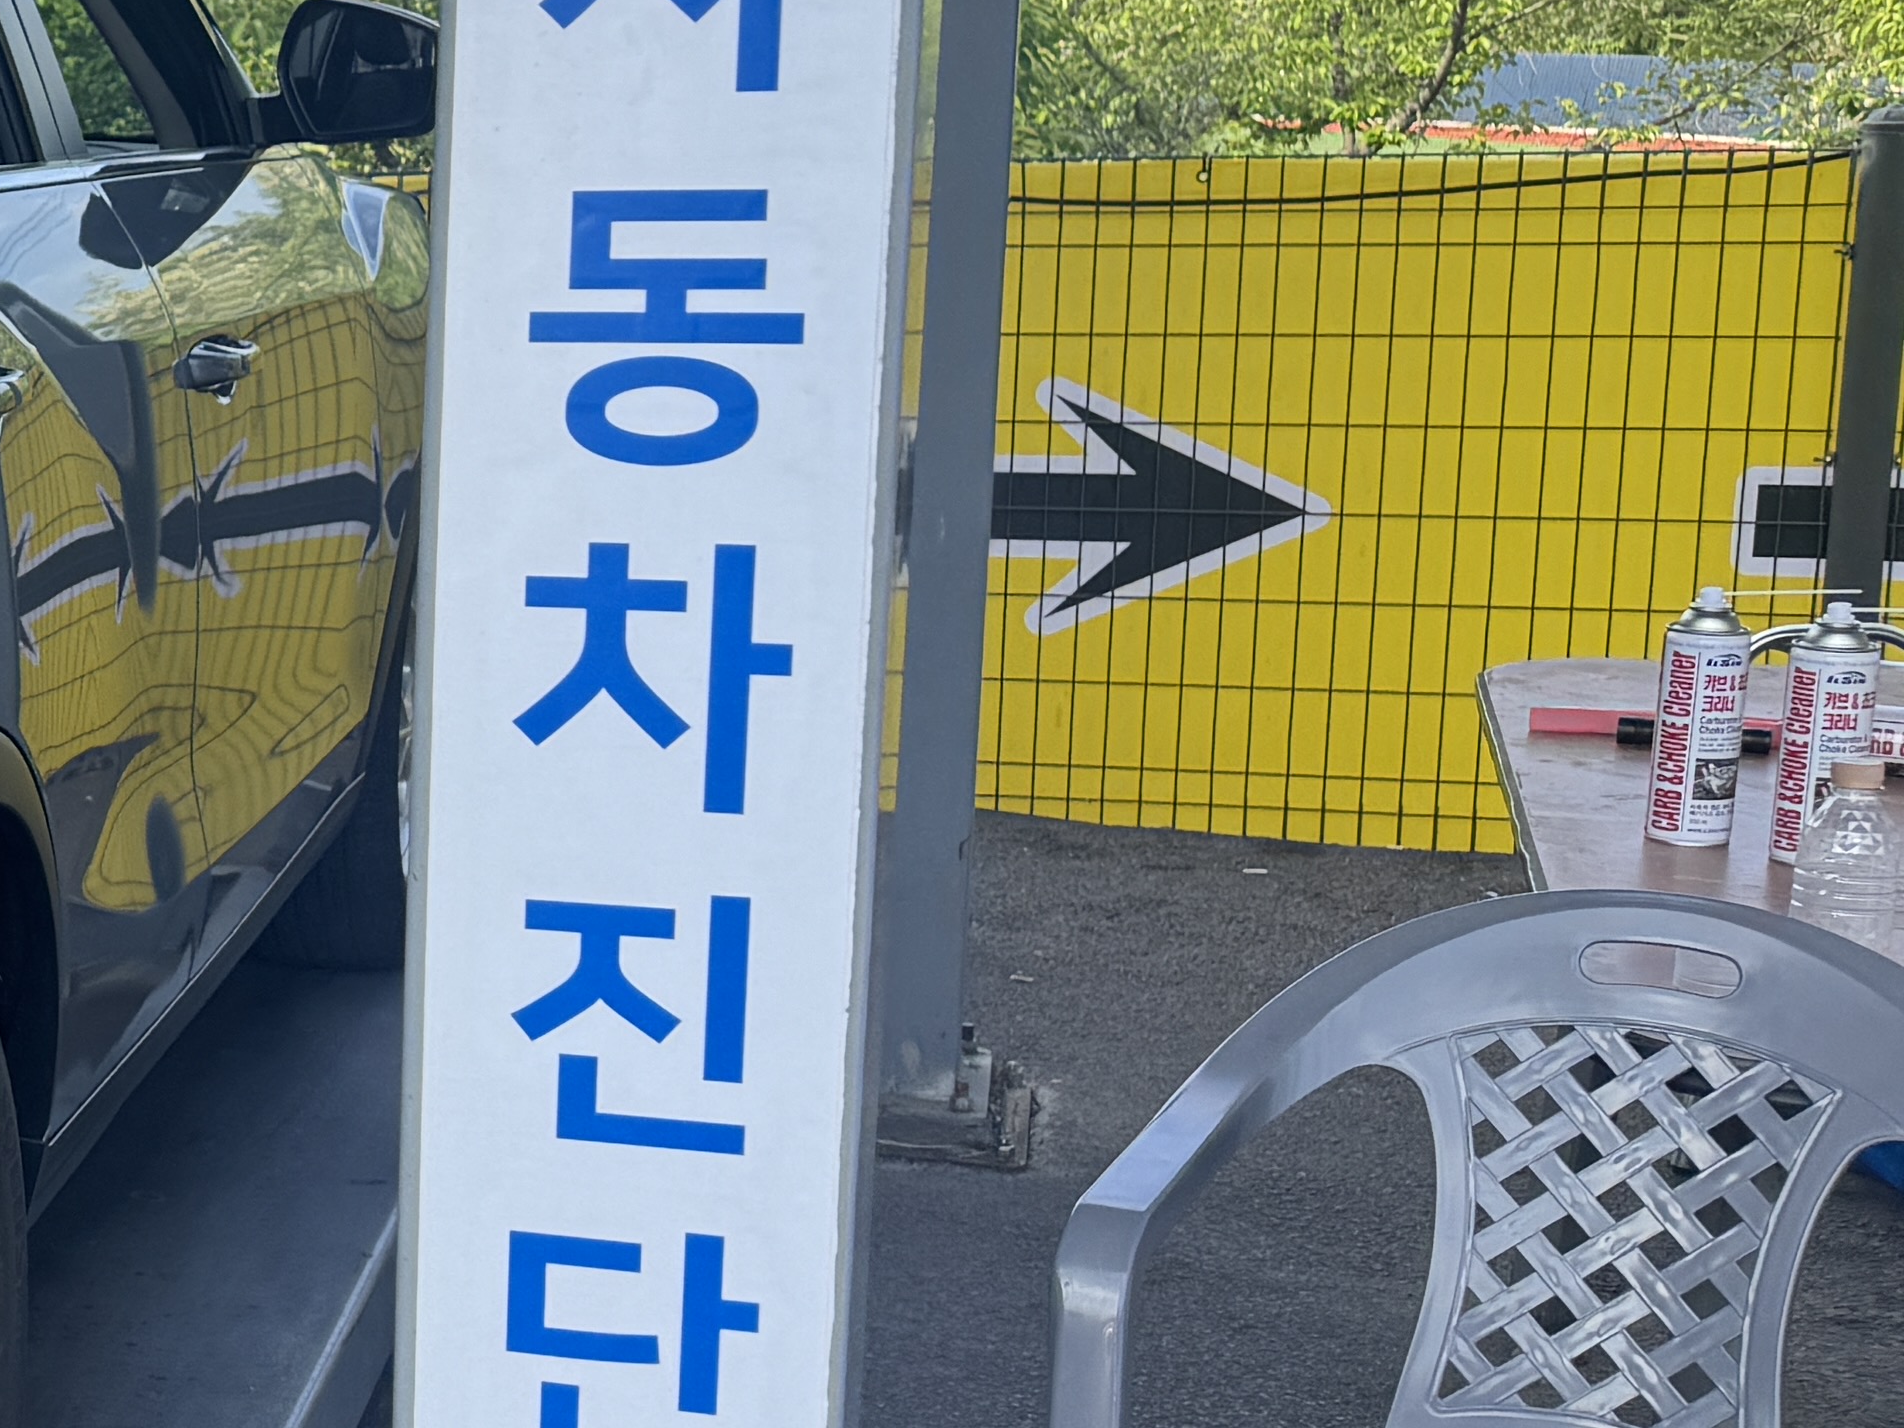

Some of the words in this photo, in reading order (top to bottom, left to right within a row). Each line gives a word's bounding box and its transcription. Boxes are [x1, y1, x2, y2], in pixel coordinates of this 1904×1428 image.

[1663, 650, 1697, 718] Cleaner
[1701, 695, 1735, 713] 크리너
[1785, 665, 1817, 736] Cleaner
[1821, 713, 1859, 731] 크리너
[1651, 788, 1682, 833] CARB
[1773, 806, 1802, 853] CARB
